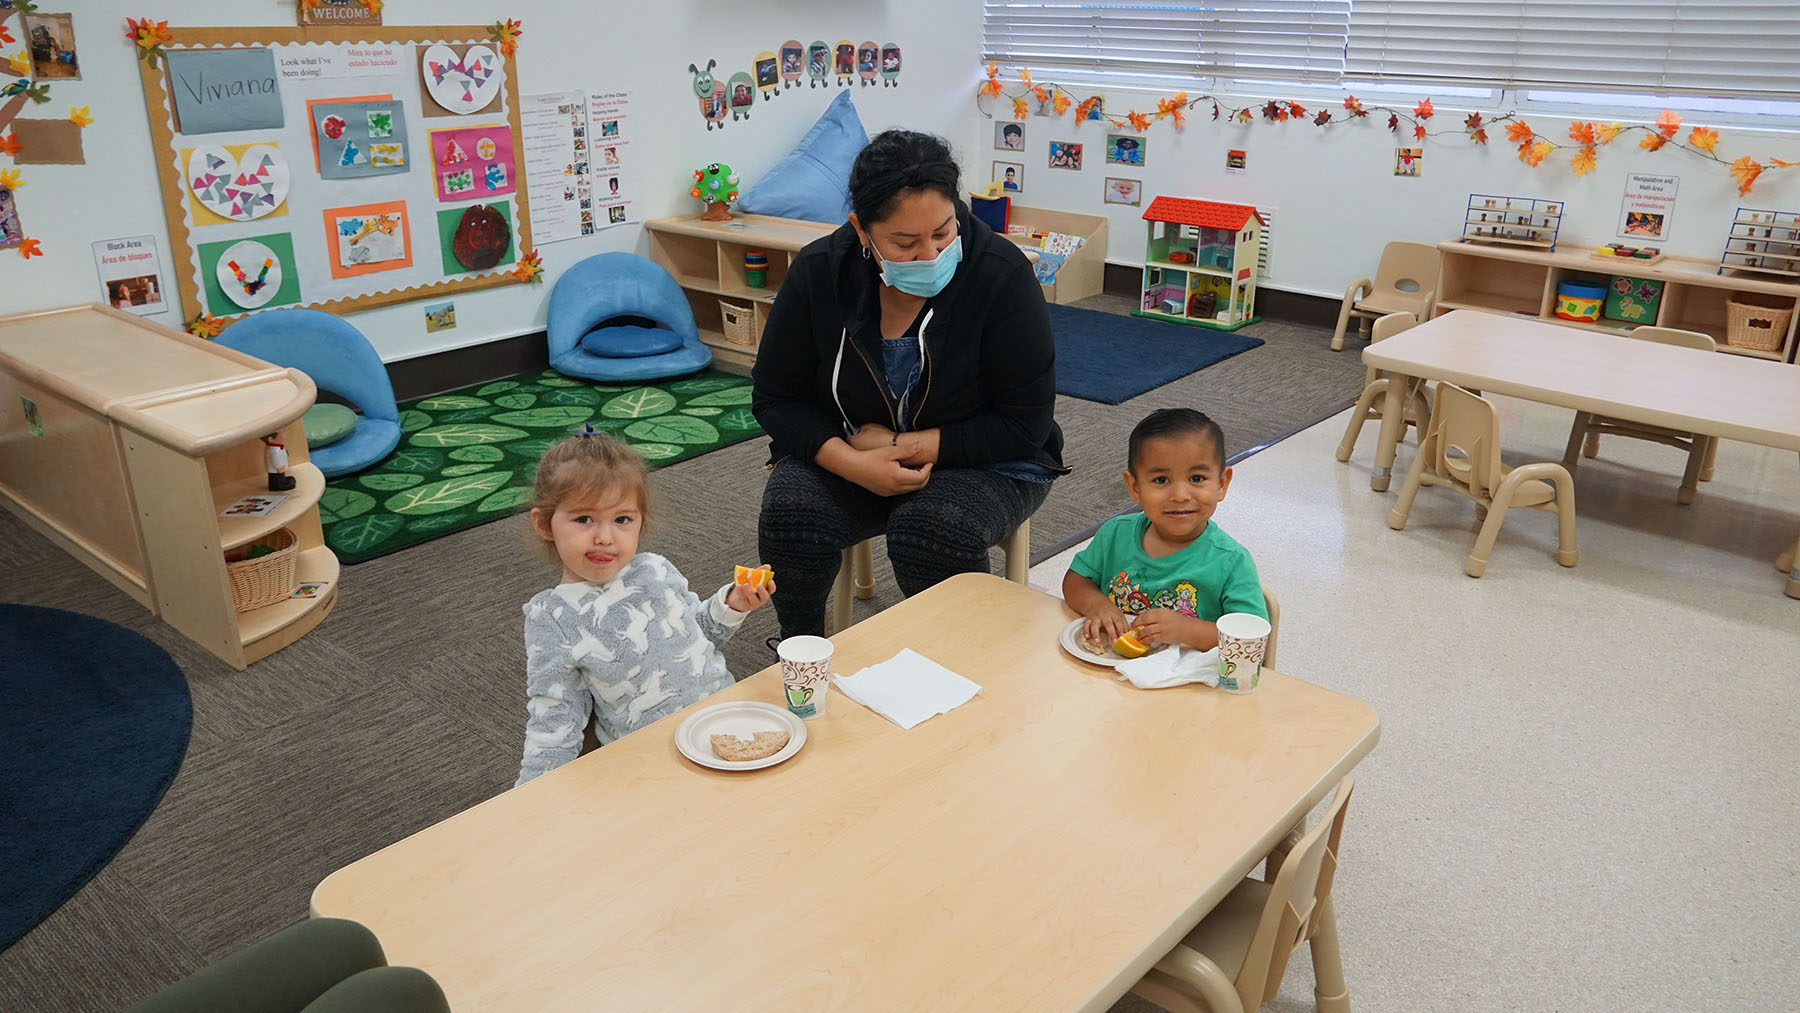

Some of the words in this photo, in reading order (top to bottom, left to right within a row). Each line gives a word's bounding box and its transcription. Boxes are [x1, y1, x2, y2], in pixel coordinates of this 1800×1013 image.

[312, 7, 370, 19] WELCOME
[281, 58, 300, 66] Look
[300, 57, 317, 65] what
[282, 69, 299, 77] been
[299, 69, 322, 77] doing!
[176, 71, 276, 105] Viviana
[108, 242, 124, 250] Block
